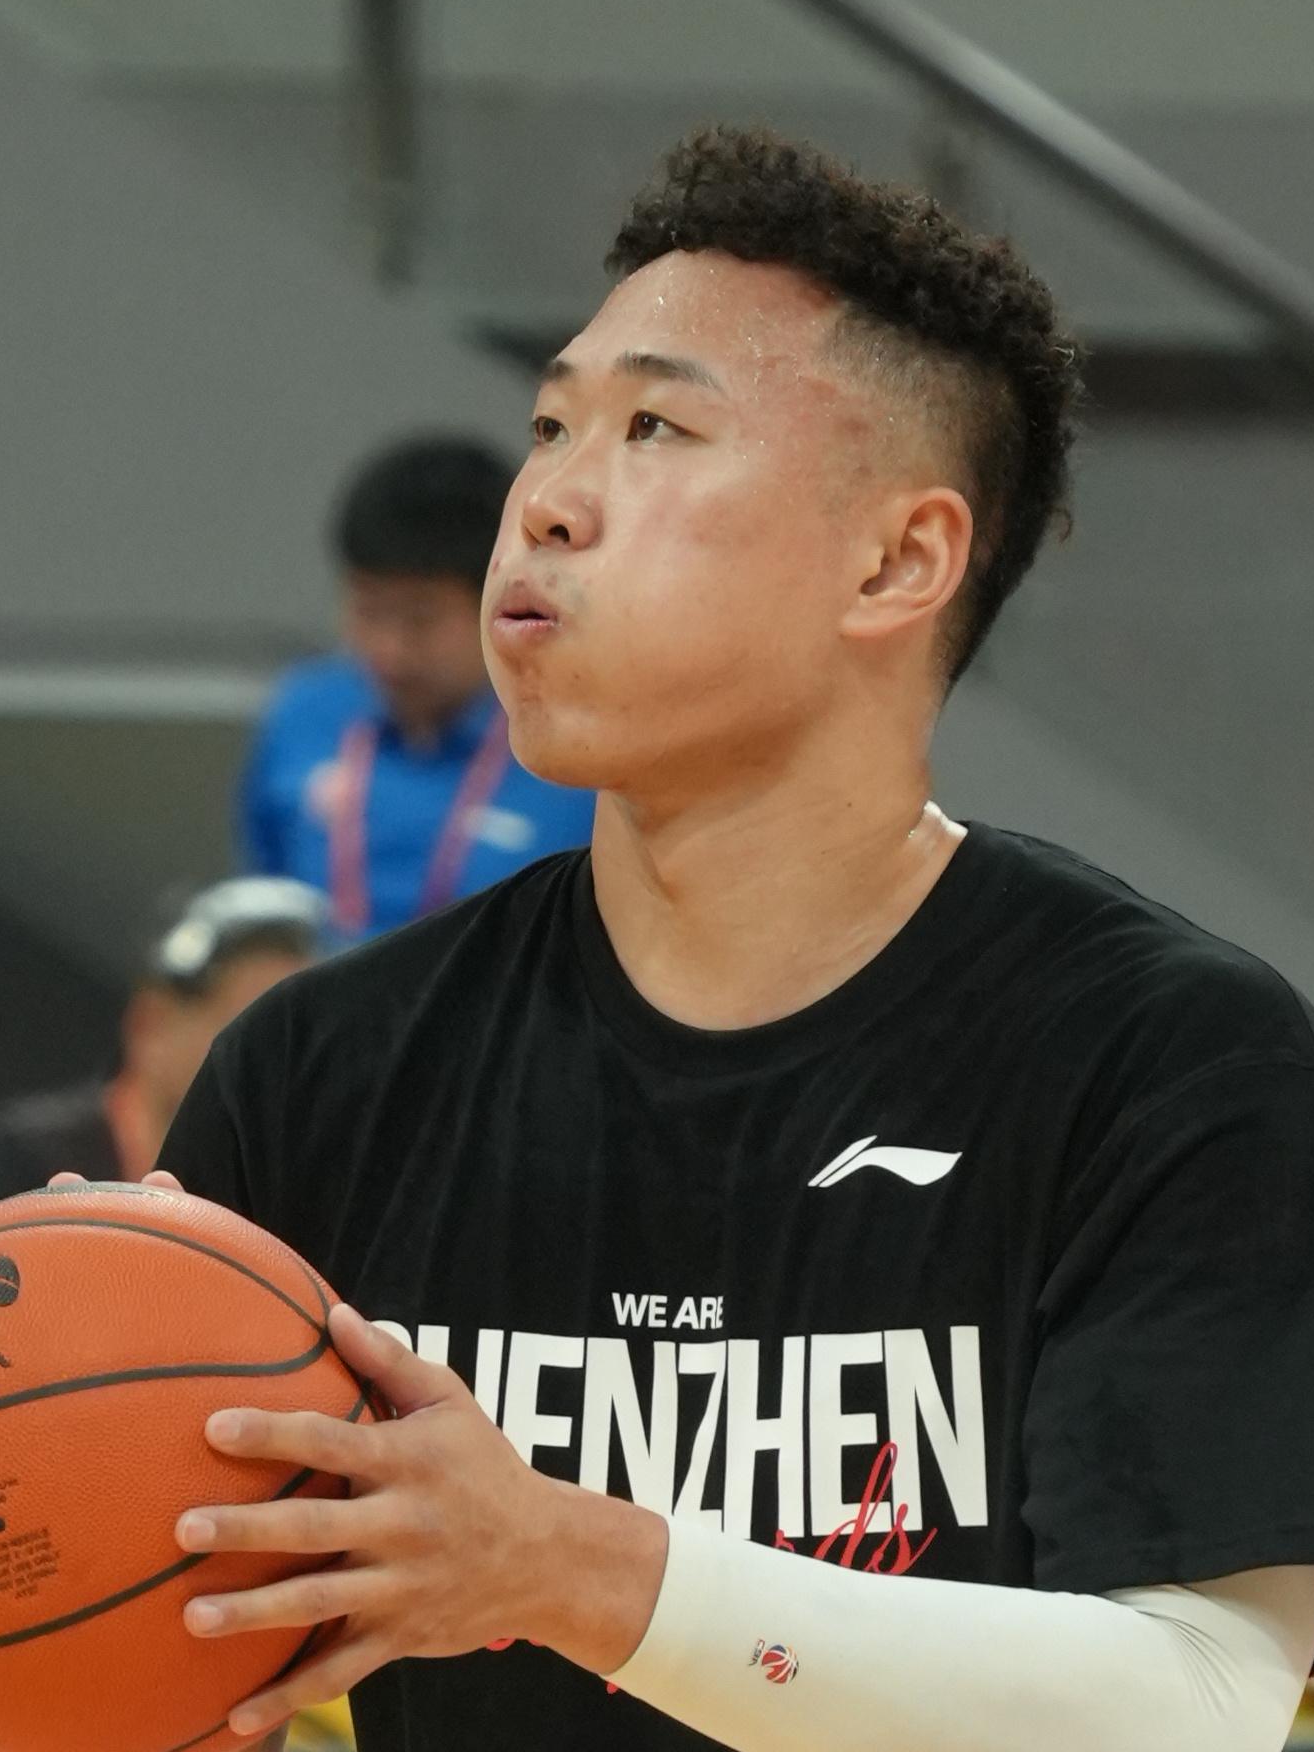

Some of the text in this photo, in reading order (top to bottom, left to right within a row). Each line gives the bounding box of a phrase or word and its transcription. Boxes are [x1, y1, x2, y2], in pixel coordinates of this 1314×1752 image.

[612, 1292, 724, 1330] WE ARE
[368, 1319, 988, 1545] ENZHEN
